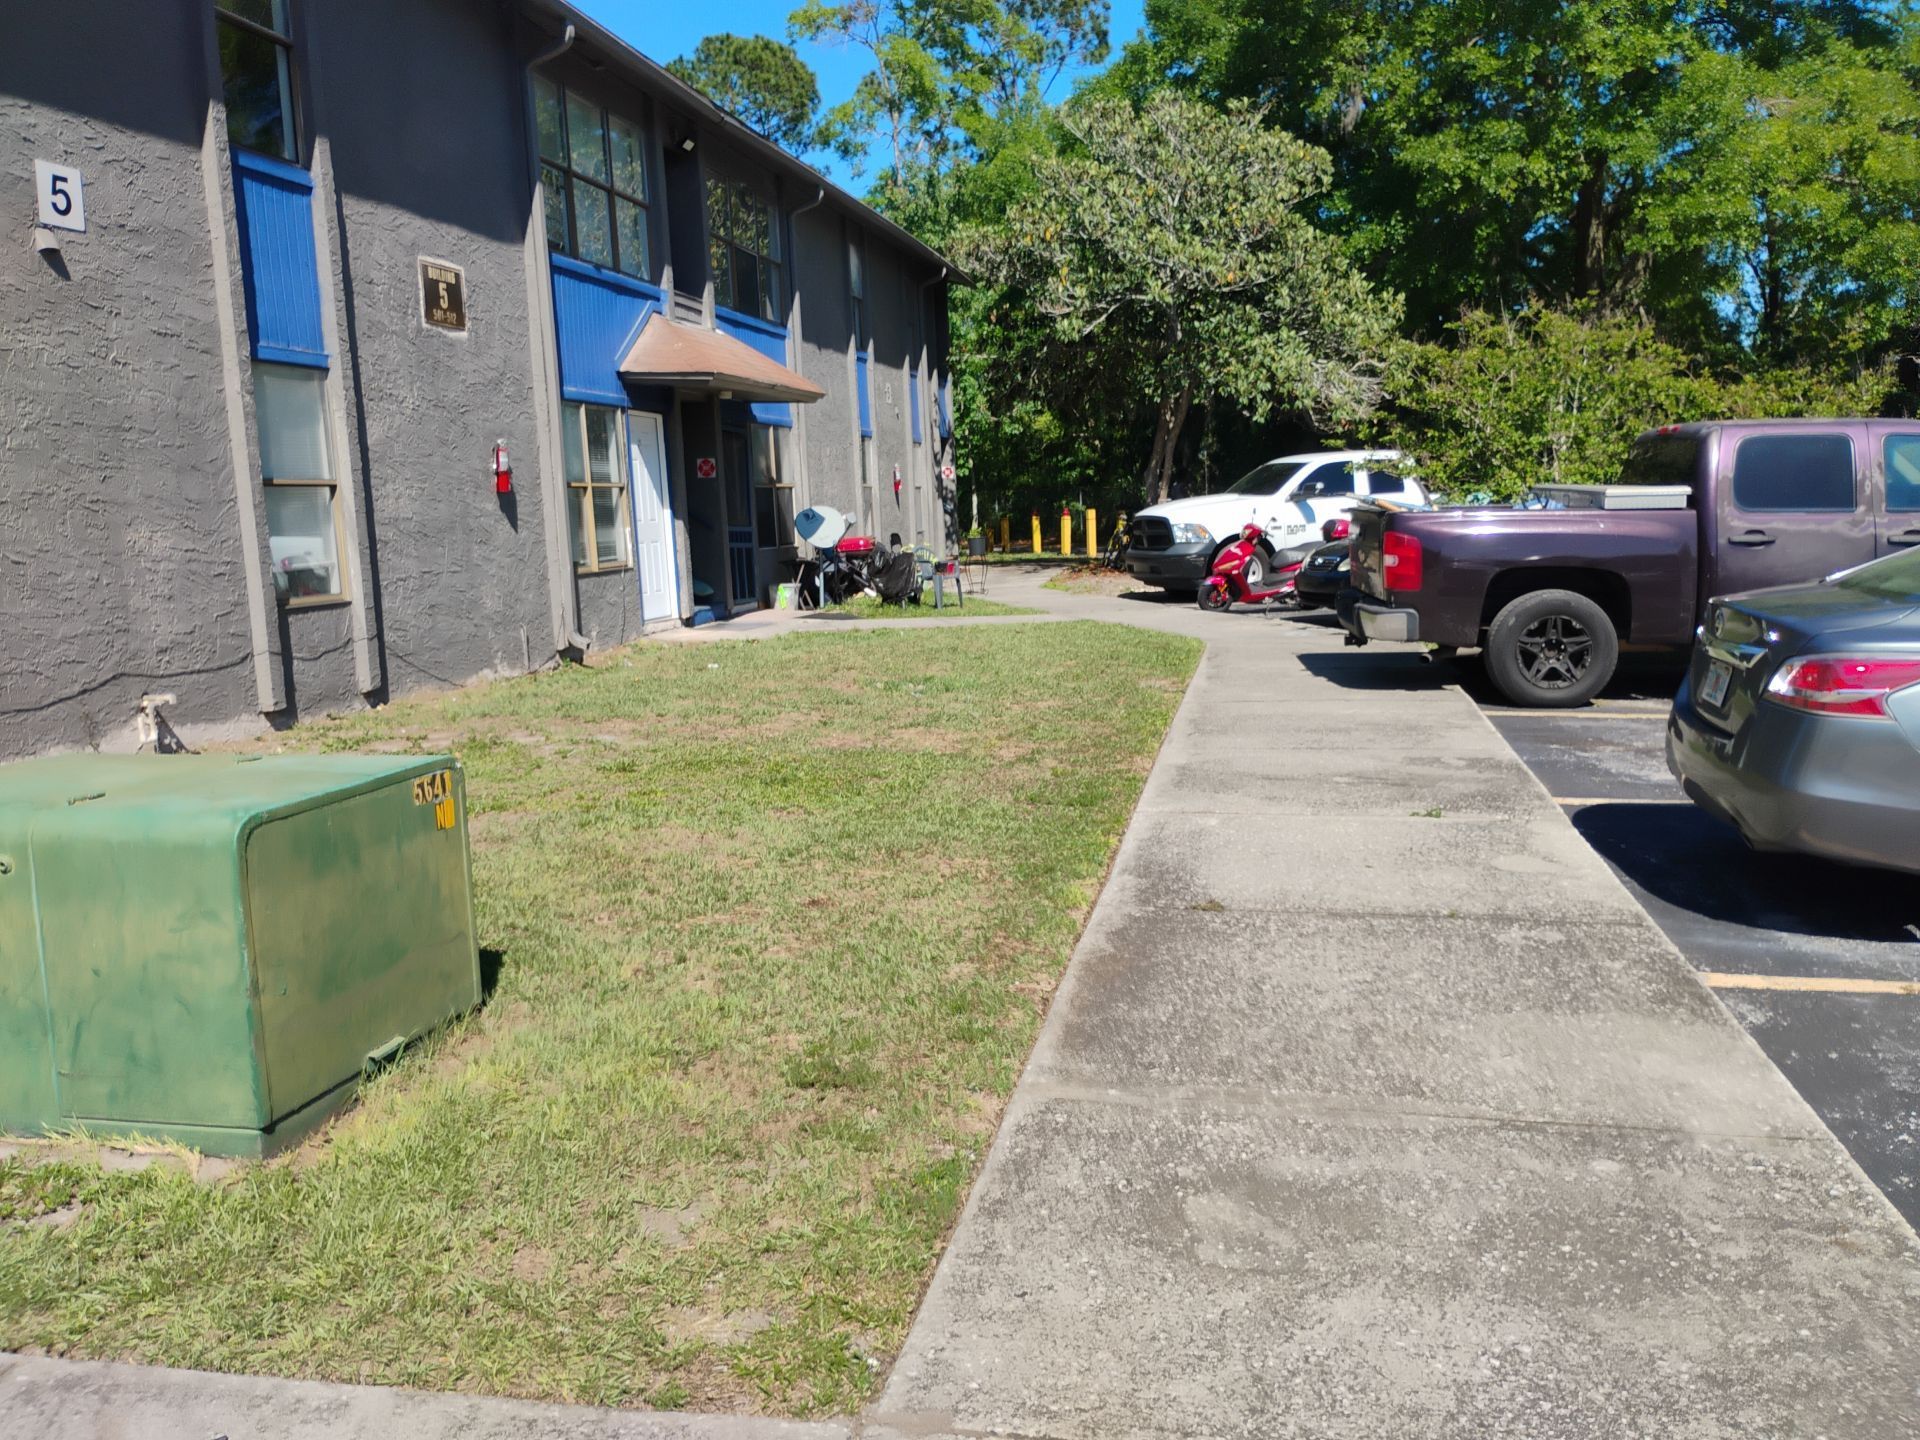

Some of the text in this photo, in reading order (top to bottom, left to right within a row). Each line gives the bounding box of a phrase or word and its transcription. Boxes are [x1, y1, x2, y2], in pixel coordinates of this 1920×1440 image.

[51, 174, 72, 217] 5
[428, 266, 456, 284] BUILDING
[438, 282, 449, 309] 5
[414, 773, 451, 804] 5641
